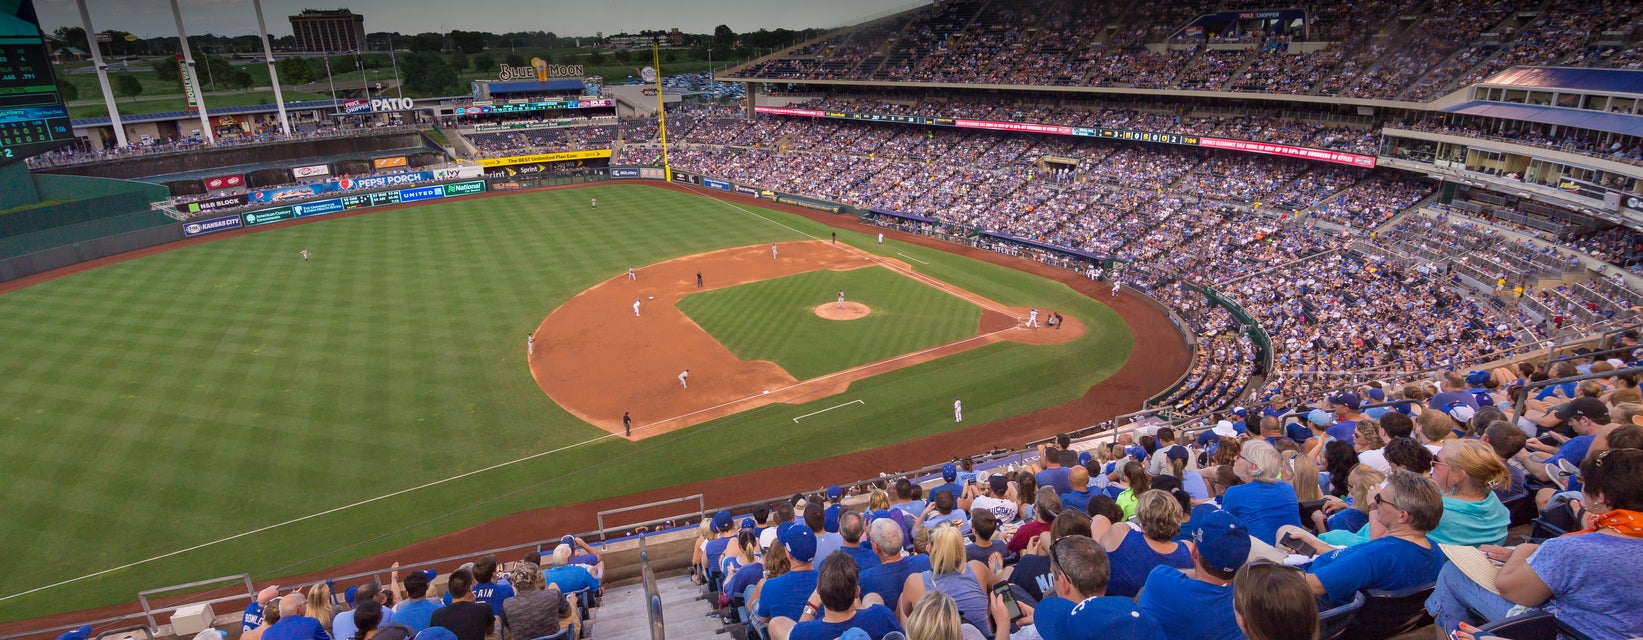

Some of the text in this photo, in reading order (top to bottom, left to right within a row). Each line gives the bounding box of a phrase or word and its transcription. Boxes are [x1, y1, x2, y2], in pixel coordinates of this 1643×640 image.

[500, 64, 583, 81] BLUE MOON
[345, 100, 360, 108] PRICE
[371, 97, 414, 111] PATIO
[346, 104, 370, 114] CHOPPER
[4, 149, 13, 157] 2
[447, 169, 460, 177] Ivy
[520, 166, 538, 174] Sprint
[358, 173, 420, 188] PEPSI PORCH
[455, 183, 481, 192] National
[403, 190, 434, 199] UNITED
[216, 198, 239, 207] BLOCK
[202, 218, 239, 230] KANSAS CITY
[988, 506, 1015, 519] USTAKAS
